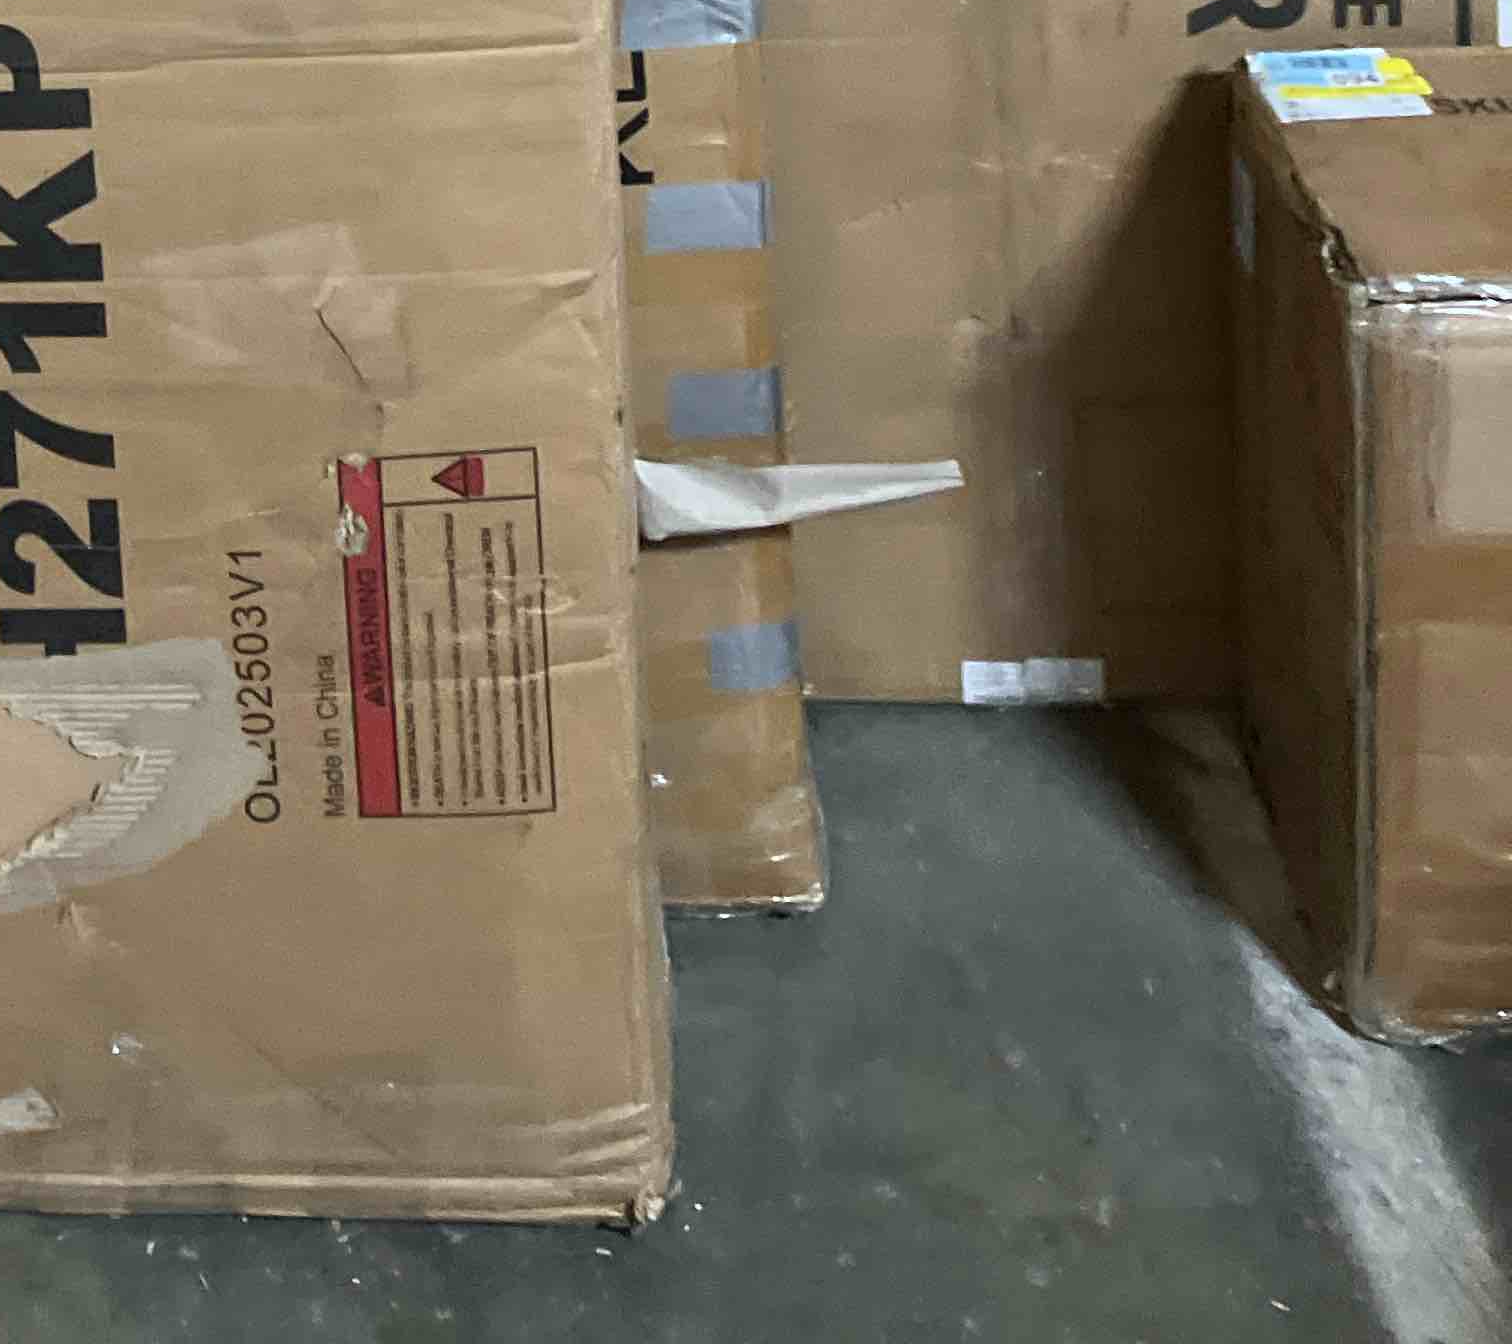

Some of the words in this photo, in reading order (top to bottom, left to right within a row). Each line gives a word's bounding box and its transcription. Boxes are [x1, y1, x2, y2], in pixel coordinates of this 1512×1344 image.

[353, 566, 389, 688] WARNING
[313, 653, 338, 722] China
[320, 730, 341, 754] in
[322, 755, 346, 818] Made
